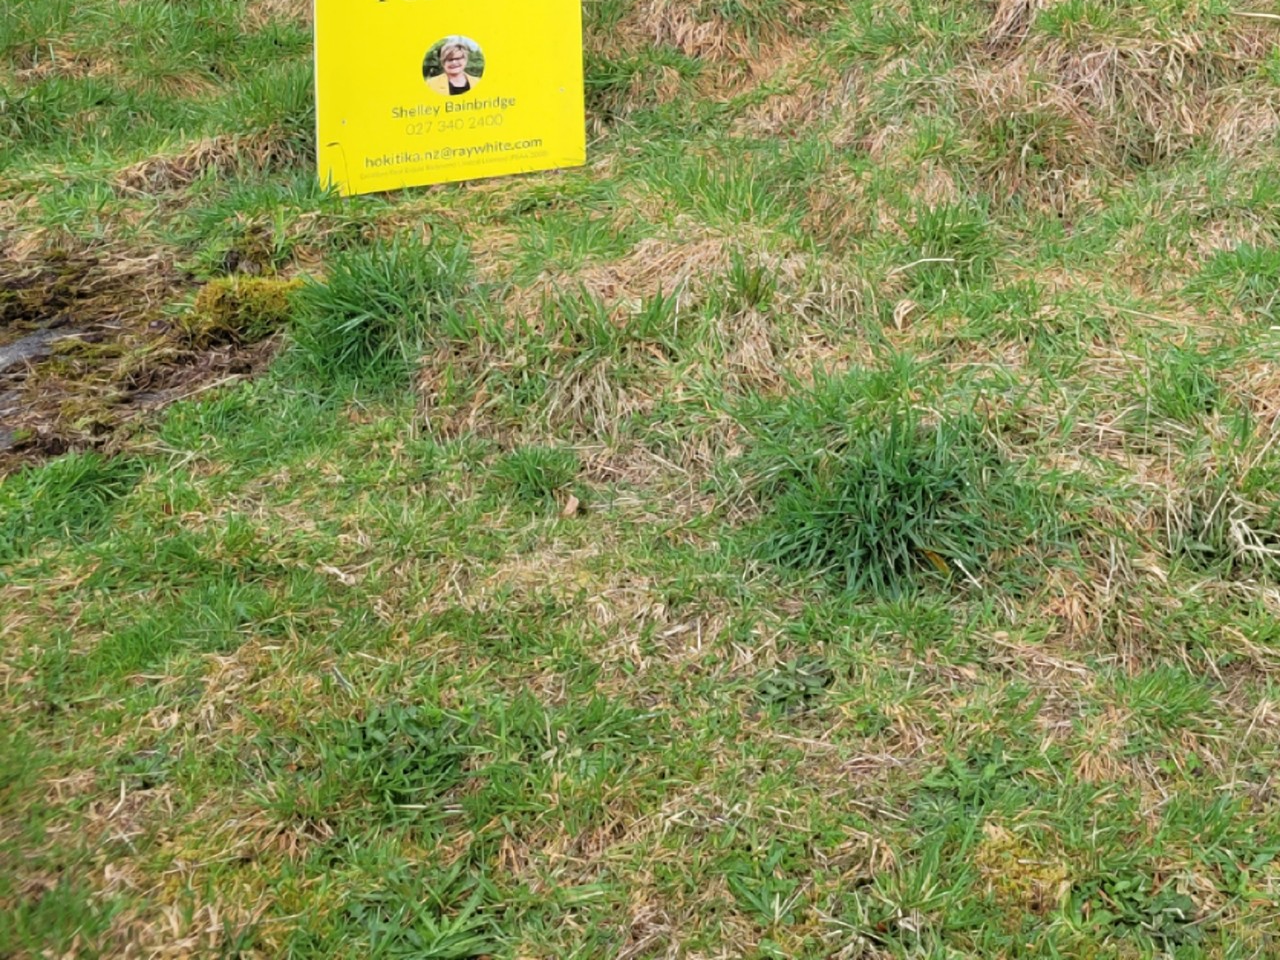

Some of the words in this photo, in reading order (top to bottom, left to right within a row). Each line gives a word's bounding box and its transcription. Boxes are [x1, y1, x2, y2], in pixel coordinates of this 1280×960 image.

[391, 104, 440, 119] Shelley
[445, 96, 516, 113] Bainbridge
[405, 121, 432, 136] 027
[437, 117, 464, 133] 340
[468, 113, 503, 130] 2400
[365, 138, 542, 168] hokitika.nz@raywhite.com
